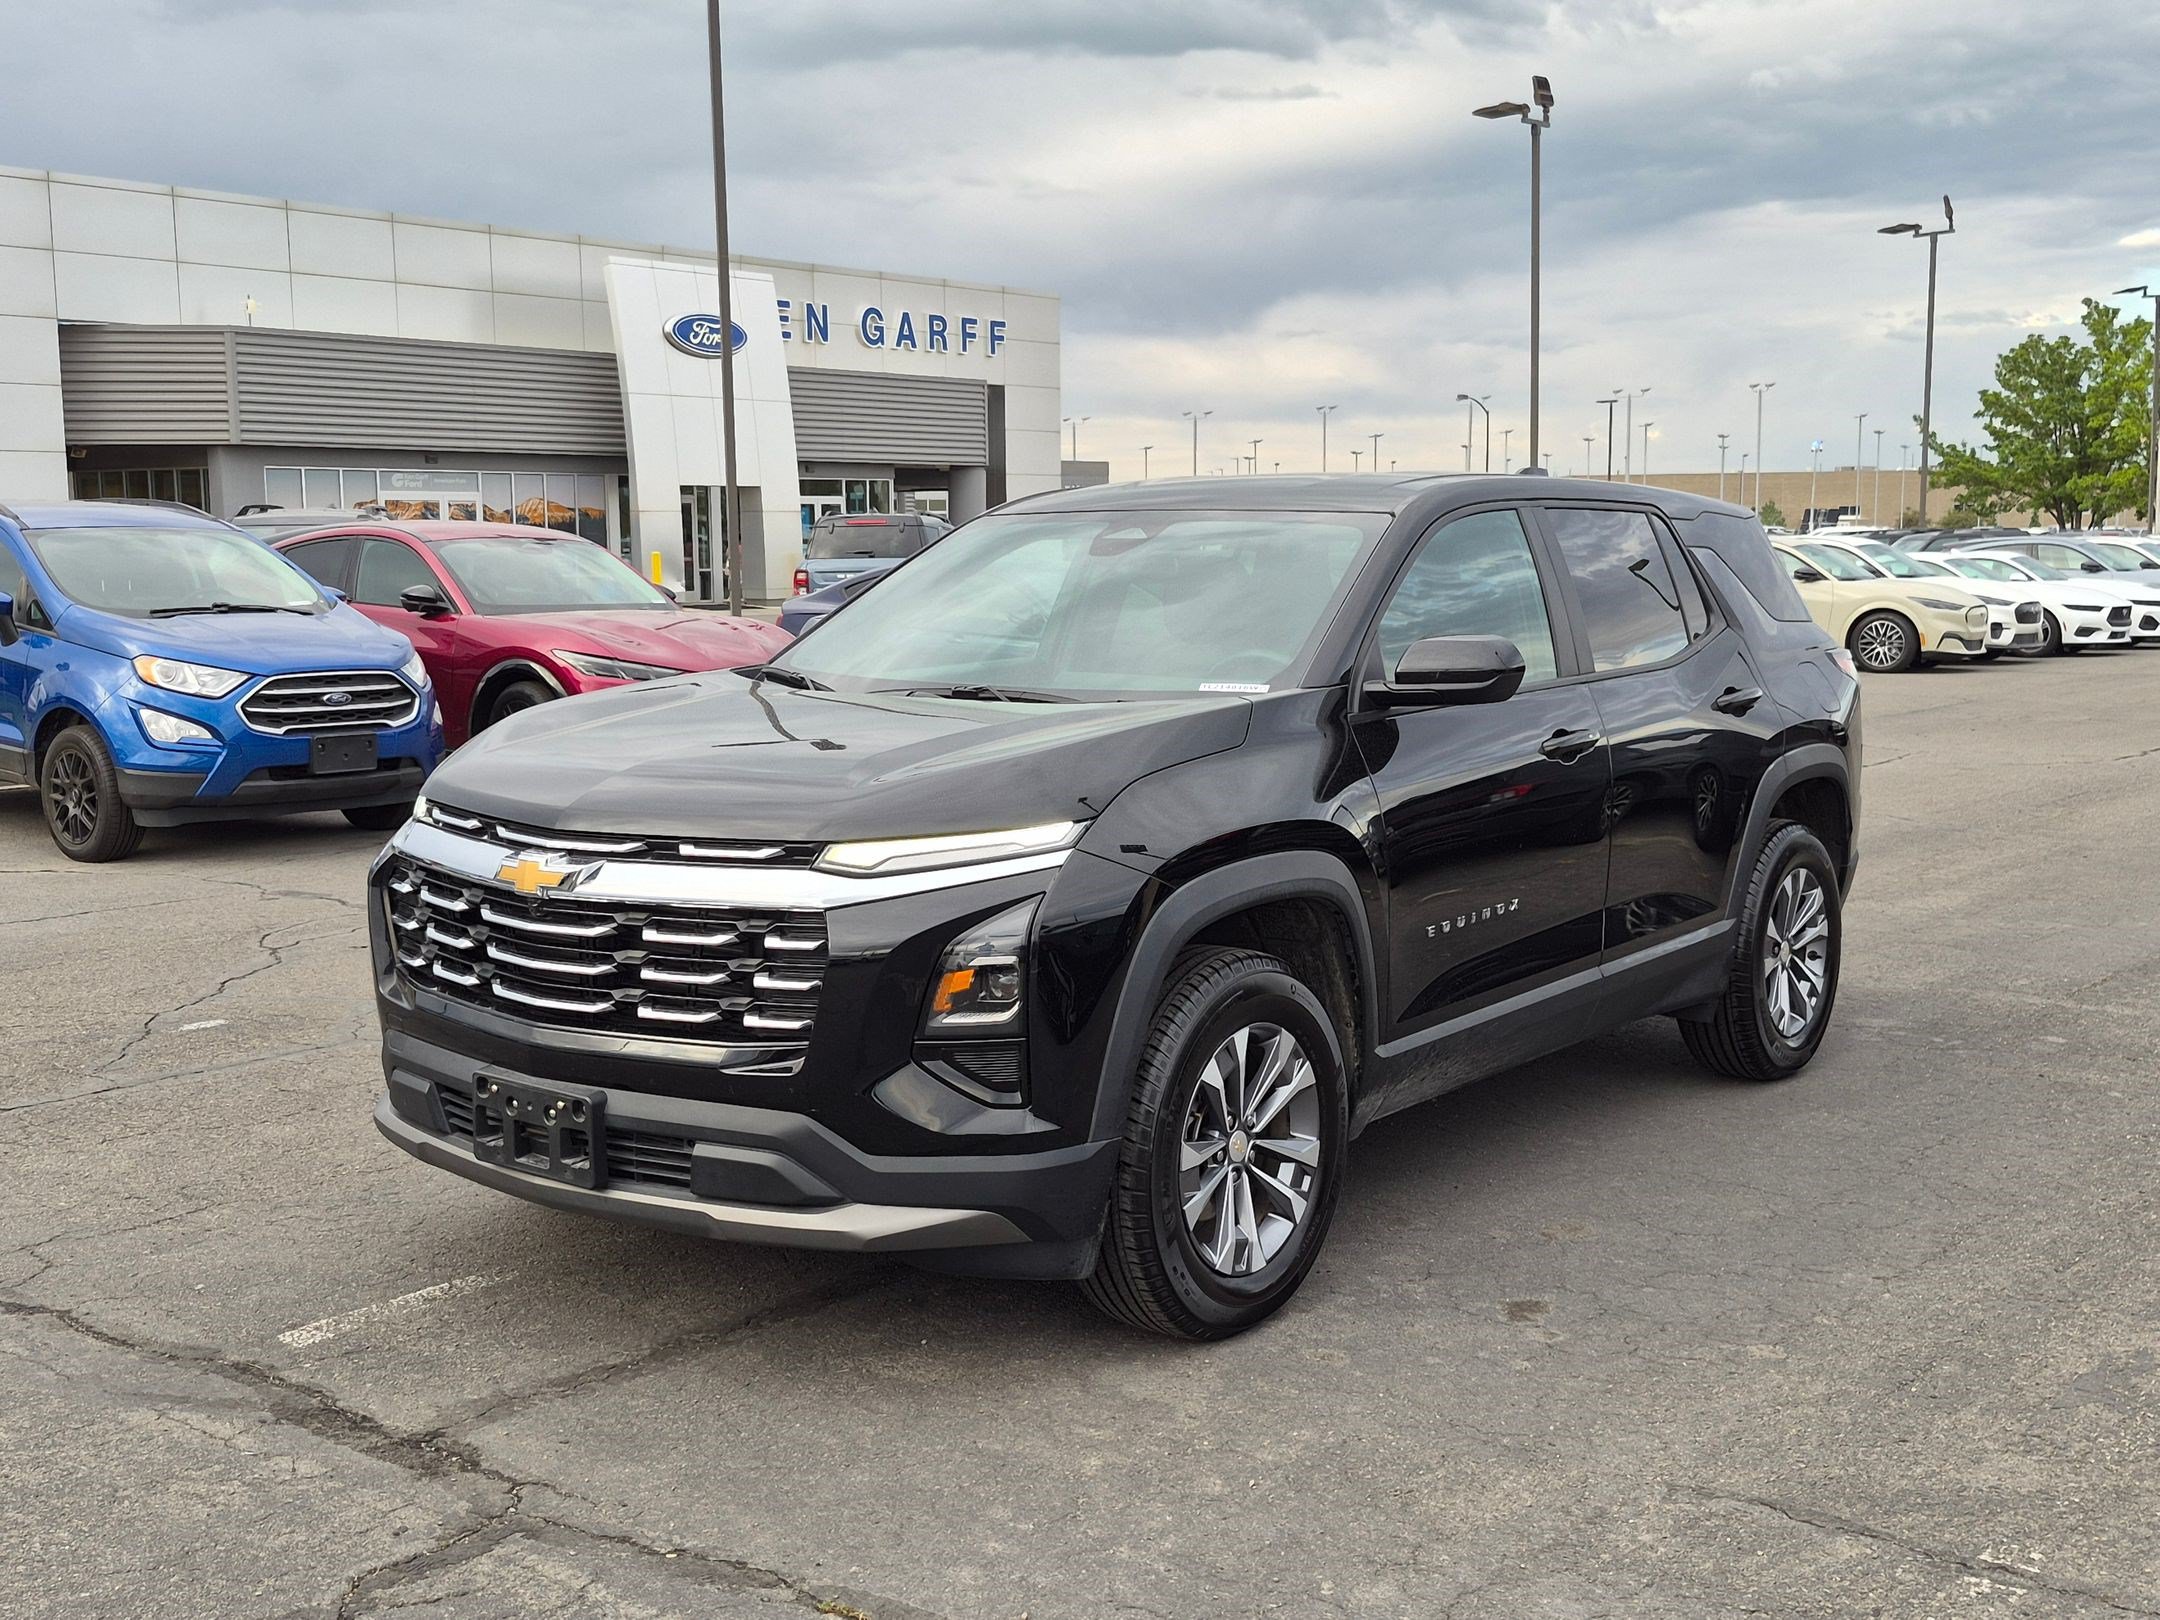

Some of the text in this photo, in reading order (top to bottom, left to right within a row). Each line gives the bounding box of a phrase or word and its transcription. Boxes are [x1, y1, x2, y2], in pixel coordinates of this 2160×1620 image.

[689, 320, 722, 345] For
[777, 299, 1007, 357] EN GARFF
[1425, 898, 1519, 938] EQUINOX
